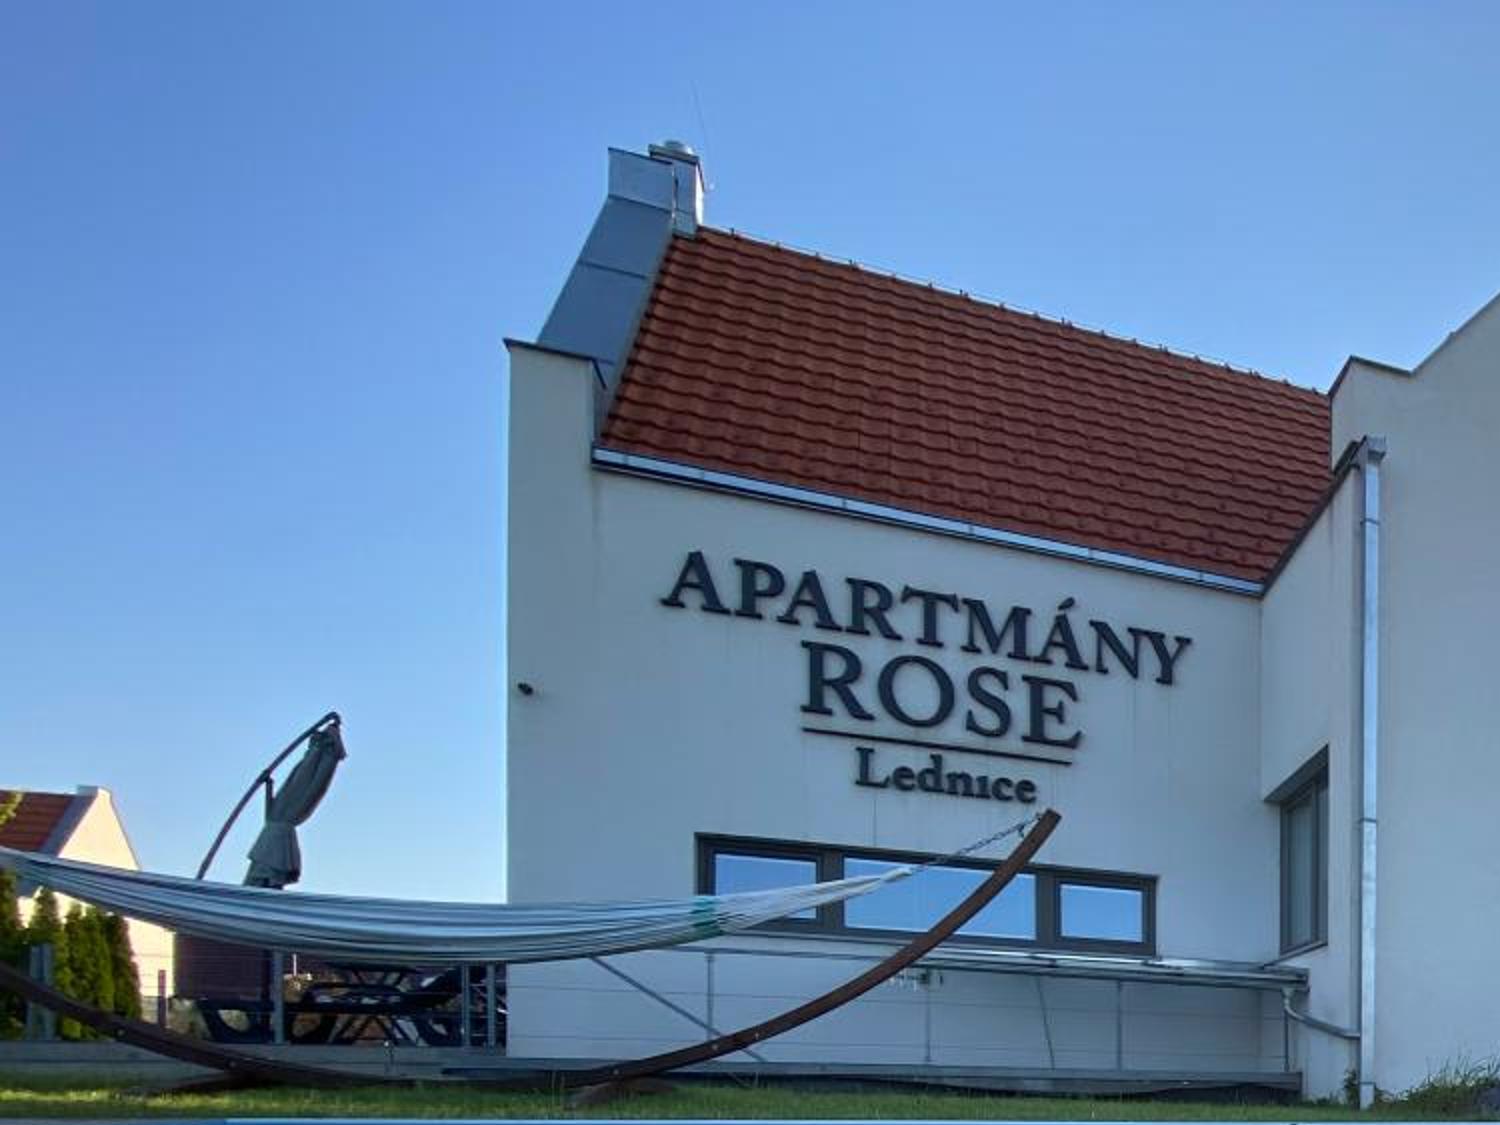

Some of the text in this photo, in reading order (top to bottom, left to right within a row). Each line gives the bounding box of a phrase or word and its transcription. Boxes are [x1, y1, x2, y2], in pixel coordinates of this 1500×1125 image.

[658, 549, 1193, 687] APARTMÁNY
[799, 639, 1084, 751] ROSE
[853, 745, 1038, 805] Lednice
